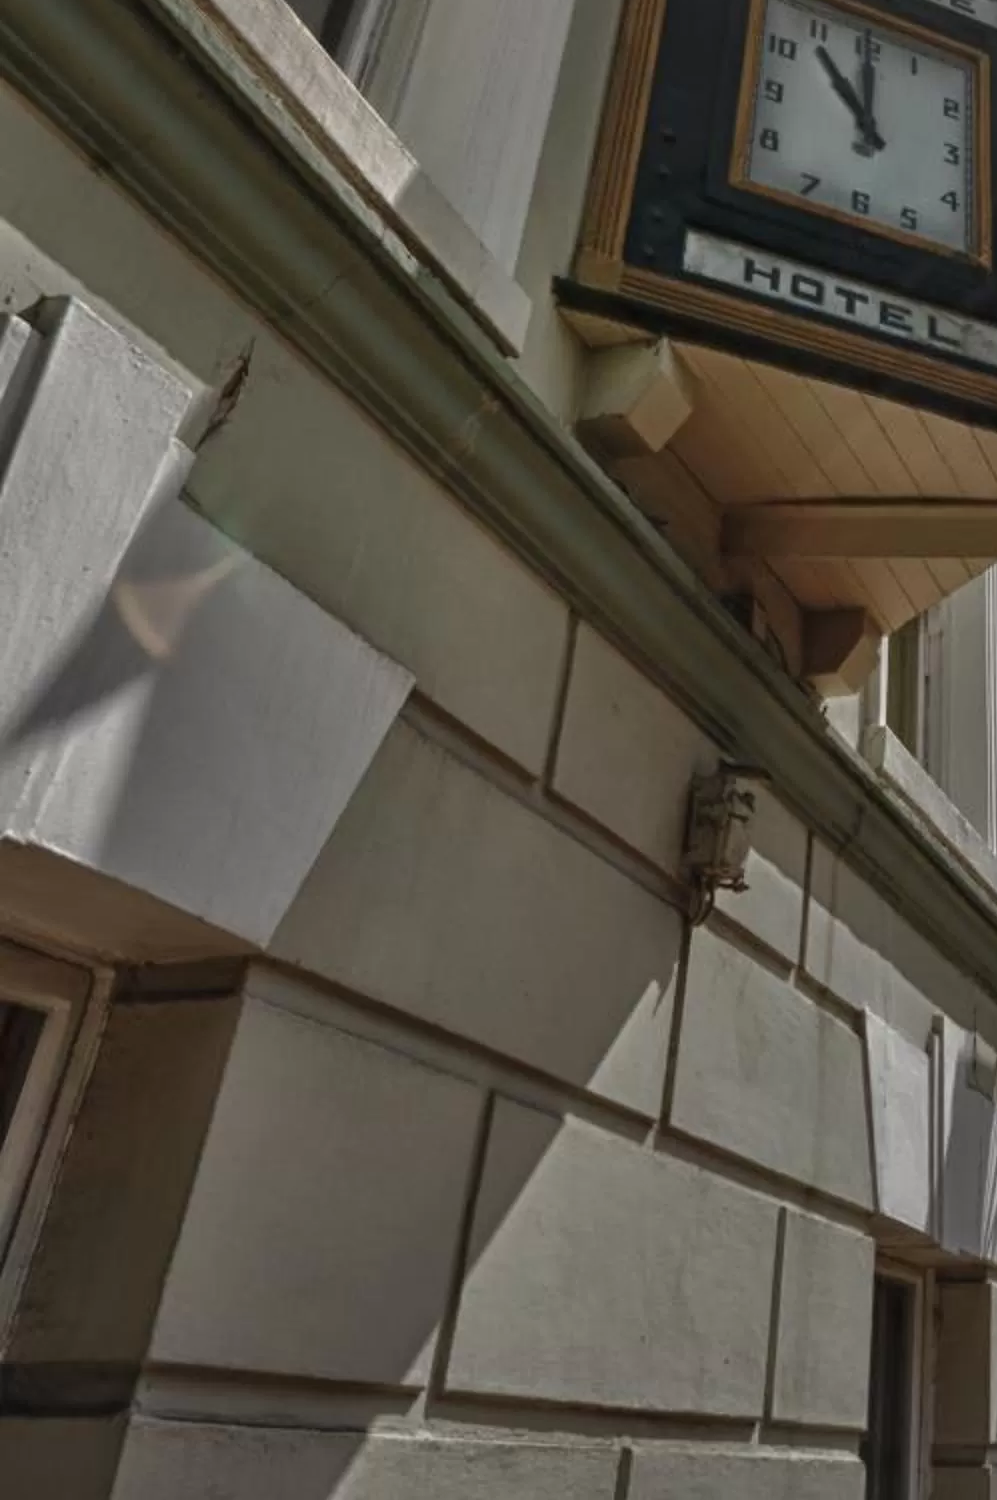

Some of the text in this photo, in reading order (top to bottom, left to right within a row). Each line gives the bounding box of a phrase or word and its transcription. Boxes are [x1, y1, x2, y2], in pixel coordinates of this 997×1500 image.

[810, 19, 828, 42] 11
[770, 35, 797, 60] 10
[911, 56, 918, 76] 1
[765, 79, 784, 104] 9
[943, 97, 960, 120] 2
[760, 128, 779, 152] 8
[943, 143, 960, 166] 3
[801, 172, 821, 195] 7
[852, 189, 870, 214] 6
[940, 191, 960, 212] 4
[901, 207, 918, 230] 5
[743, 257, 963, 348] HOTEL
